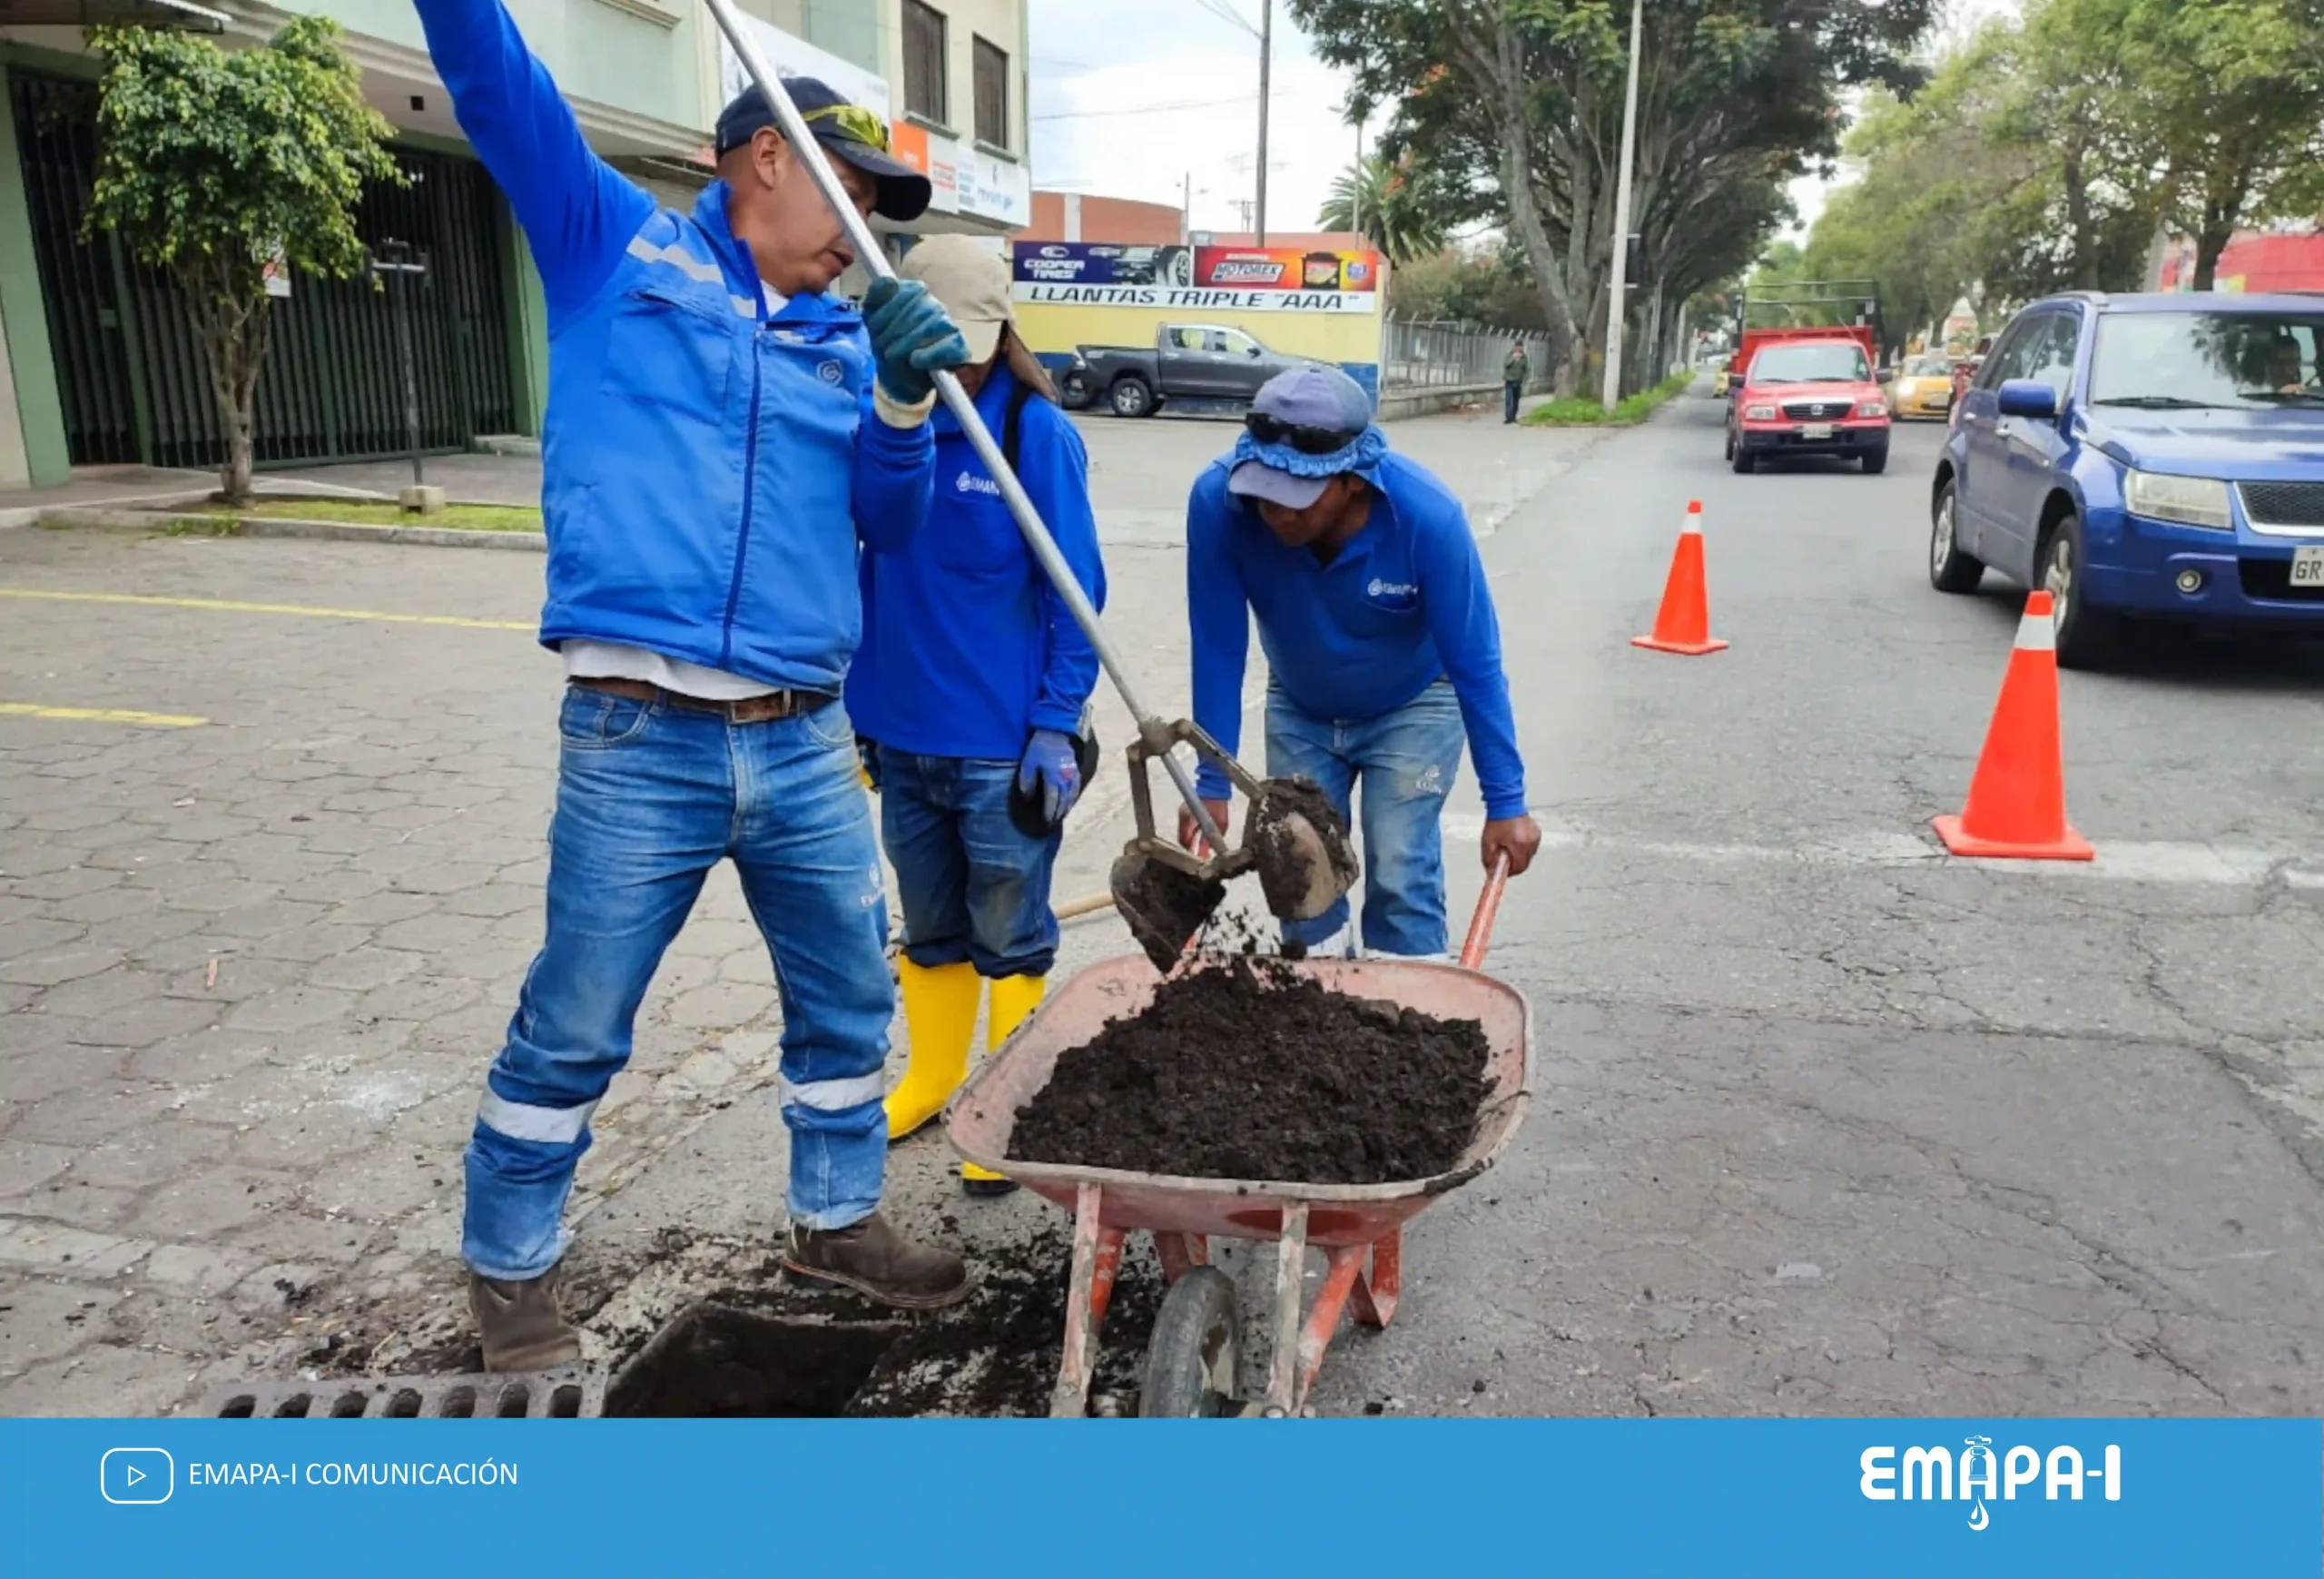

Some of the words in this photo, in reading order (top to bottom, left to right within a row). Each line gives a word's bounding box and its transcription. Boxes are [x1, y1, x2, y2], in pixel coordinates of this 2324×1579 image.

[1024, 258, 1086, 271] COOPER
[1033, 270, 1078, 280] TIRES
[1030, 286, 1157, 304] LLANTAS
[1167, 290, 1265, 308] TRIPLE
